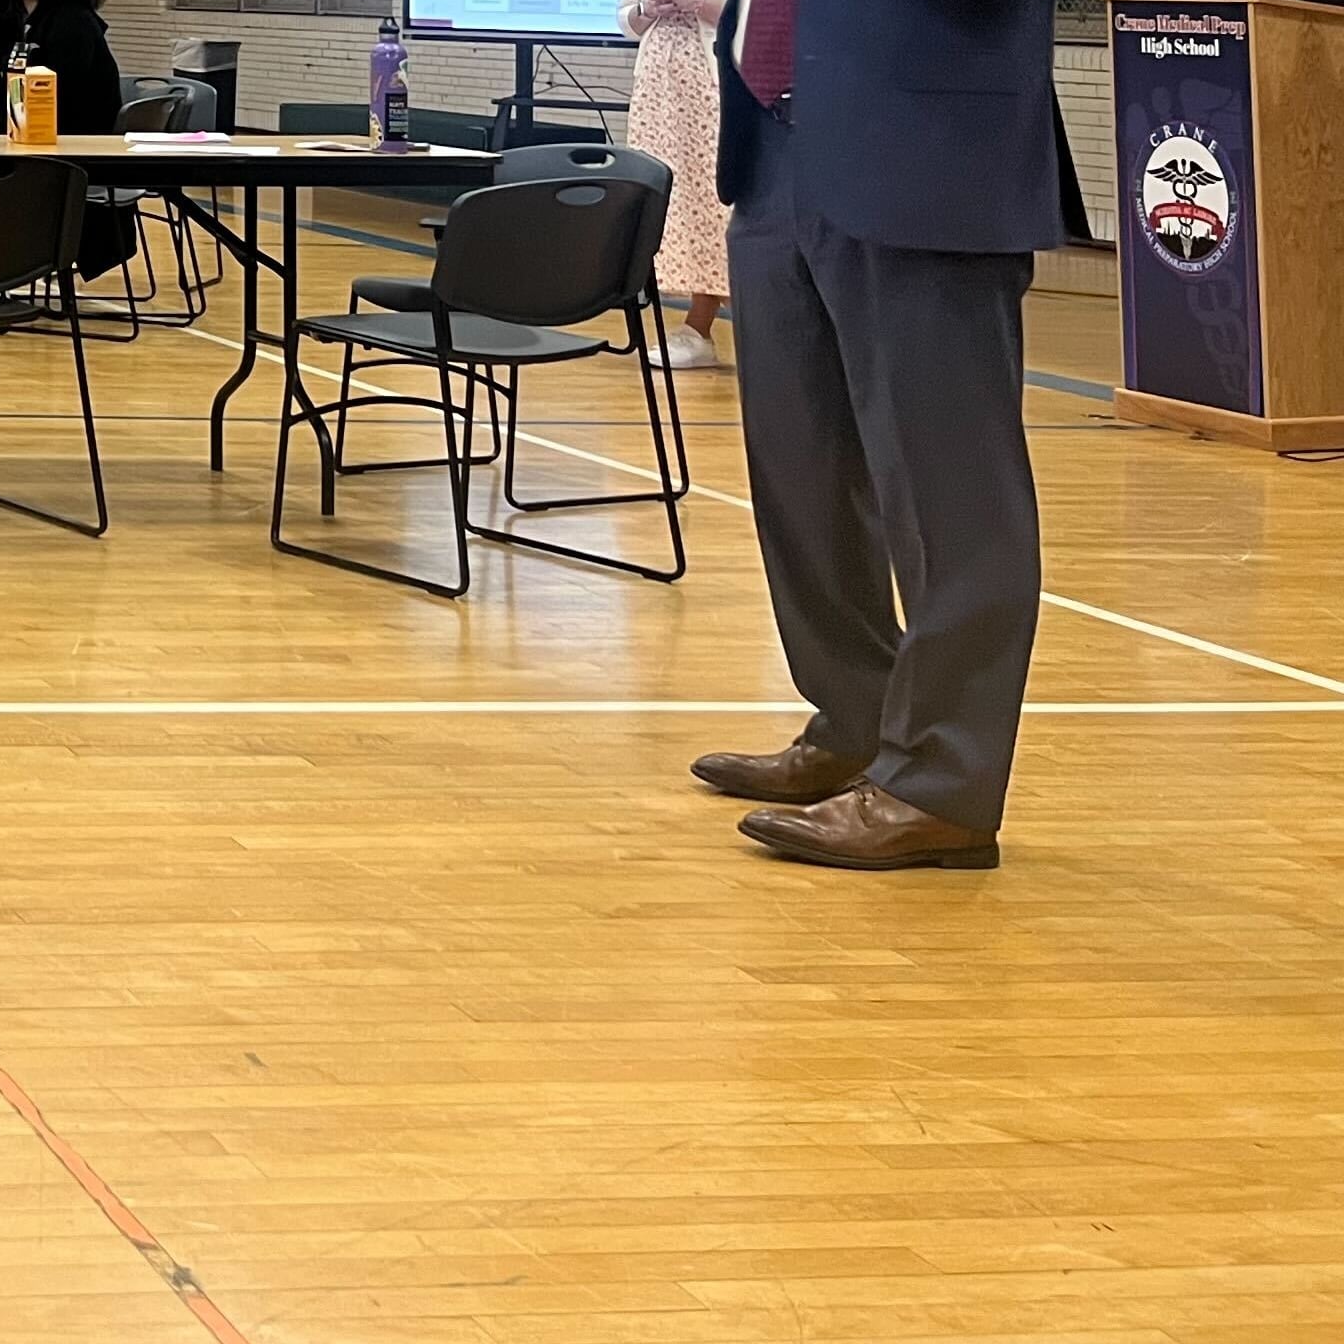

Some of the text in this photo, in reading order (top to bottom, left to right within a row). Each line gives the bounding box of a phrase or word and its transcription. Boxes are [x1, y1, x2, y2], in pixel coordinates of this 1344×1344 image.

[1115, 13, 1246, 40] Crane Medical Prep
[1141, 36, 1220, 59] High School
[1149, 122, 1218, 153] CRANE
